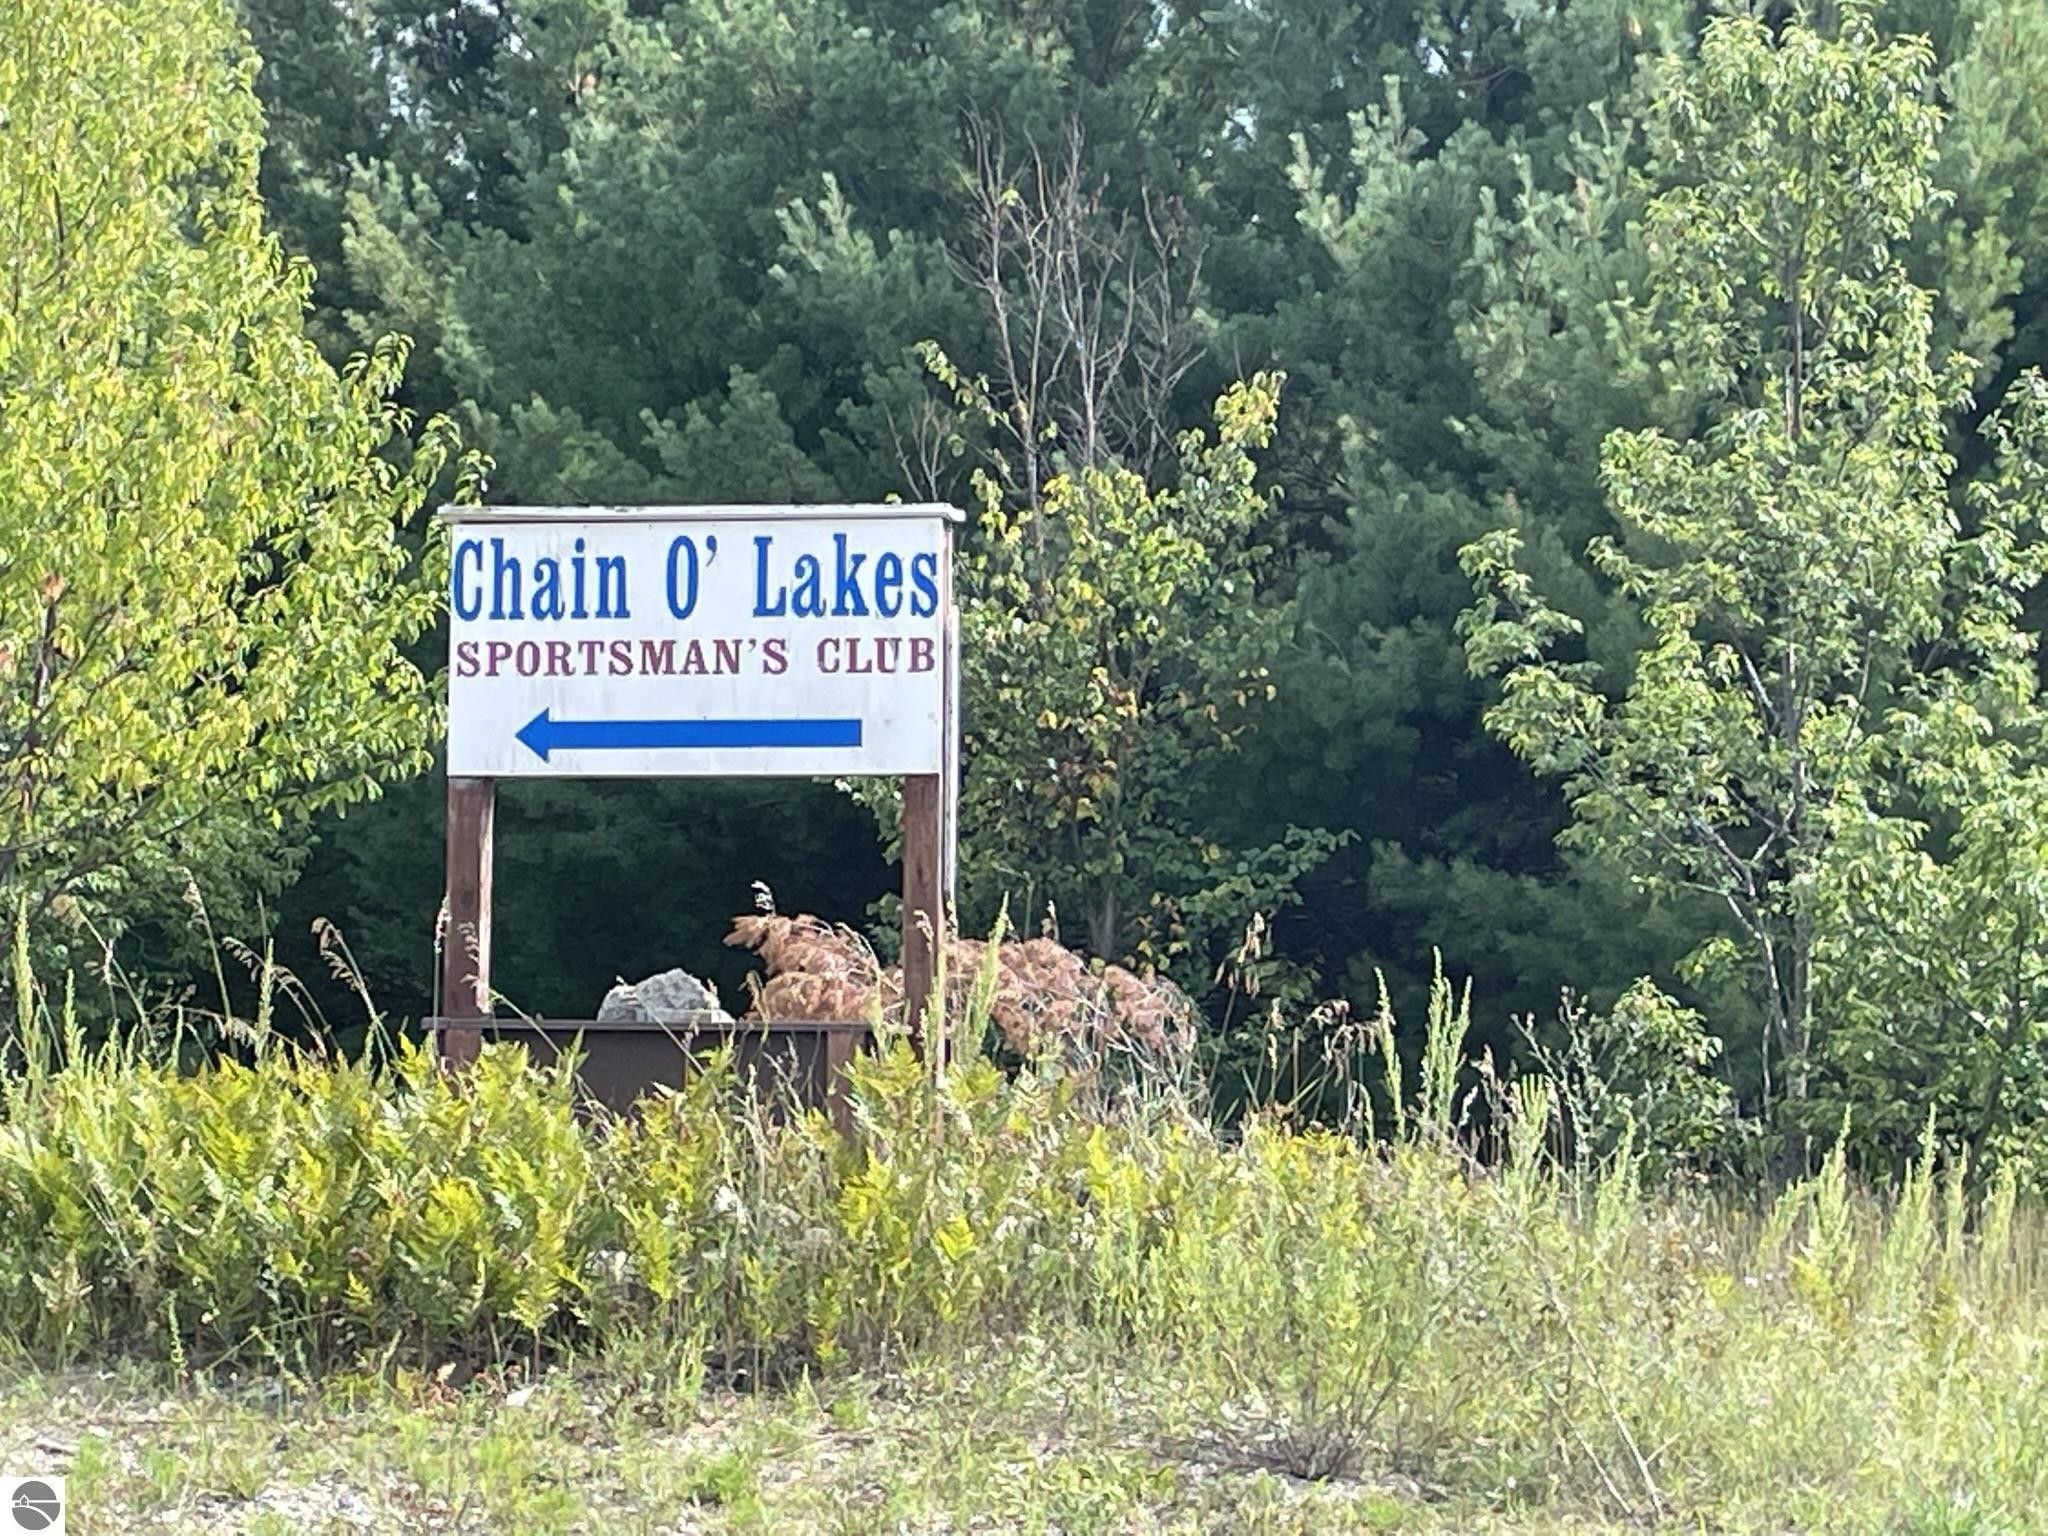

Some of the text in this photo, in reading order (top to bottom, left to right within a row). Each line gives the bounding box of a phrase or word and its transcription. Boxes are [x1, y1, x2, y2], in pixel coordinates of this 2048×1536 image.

[453, 533, 938, 621] Chain O' Lakes
[456, 637, 935, 677] SPORTSMAN'S CLUB
